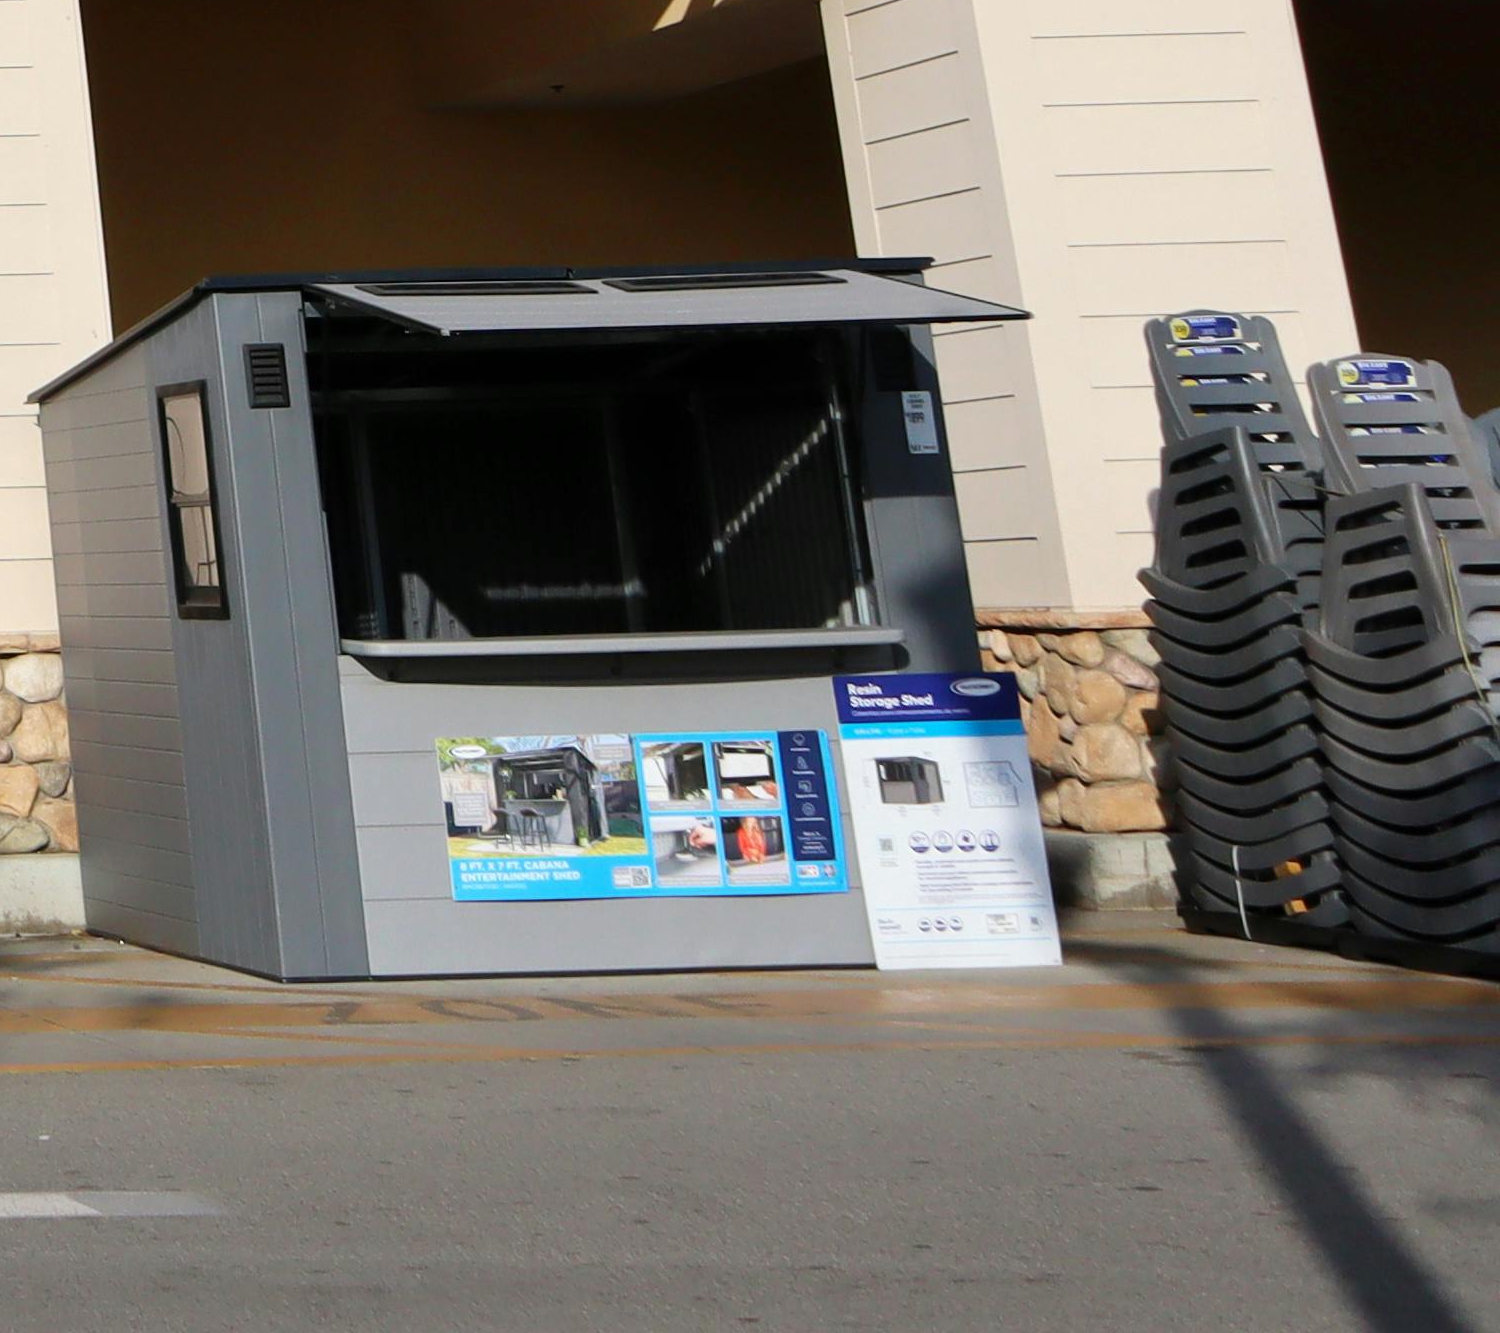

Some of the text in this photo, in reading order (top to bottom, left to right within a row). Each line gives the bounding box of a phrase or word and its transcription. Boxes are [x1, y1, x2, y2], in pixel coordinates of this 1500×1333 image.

[847, 683, 882, 695] Resin
[850, 694, 934, 709] Storage Shed
[524, 860, 569, 870] CABANA
[461, 871, 581, 882] ENTERTAINMENT SHED
